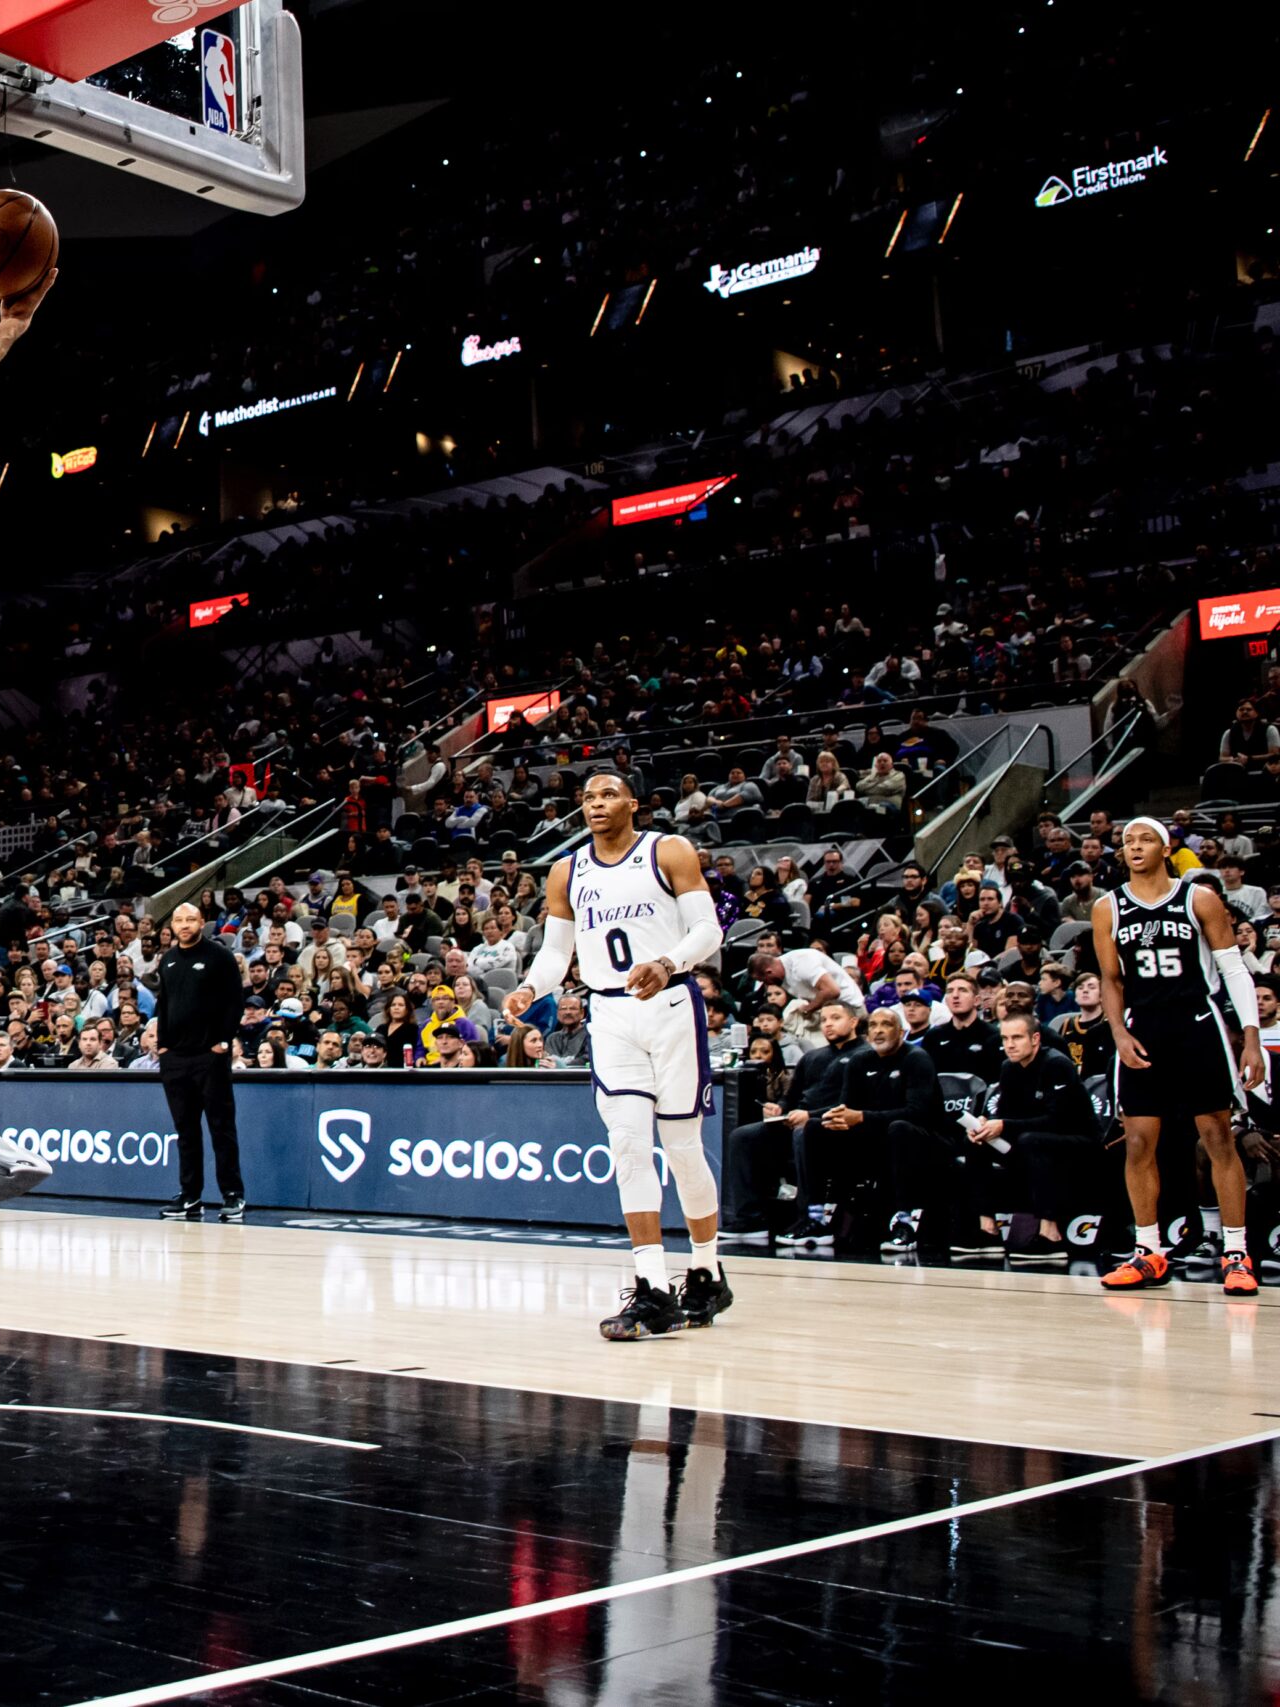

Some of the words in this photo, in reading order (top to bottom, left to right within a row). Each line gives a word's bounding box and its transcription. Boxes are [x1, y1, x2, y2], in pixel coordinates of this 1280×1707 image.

[208, 107, 224, 128] NBA
[1072, 145, 1168, 188] Firstmark
[1075, 181, 1109, 197] Credit
[736, 246, 820, 281] Germania
[215, 396, 279, 428] Methodist
[580, 902, 656, 932] ANGELES
[1117, 919, 1193, 948] SPURS
[605, 927, 634, 973] 0
[1135, 947, 1183, 978] 35
[944, 1096, 972, 1112] ost
